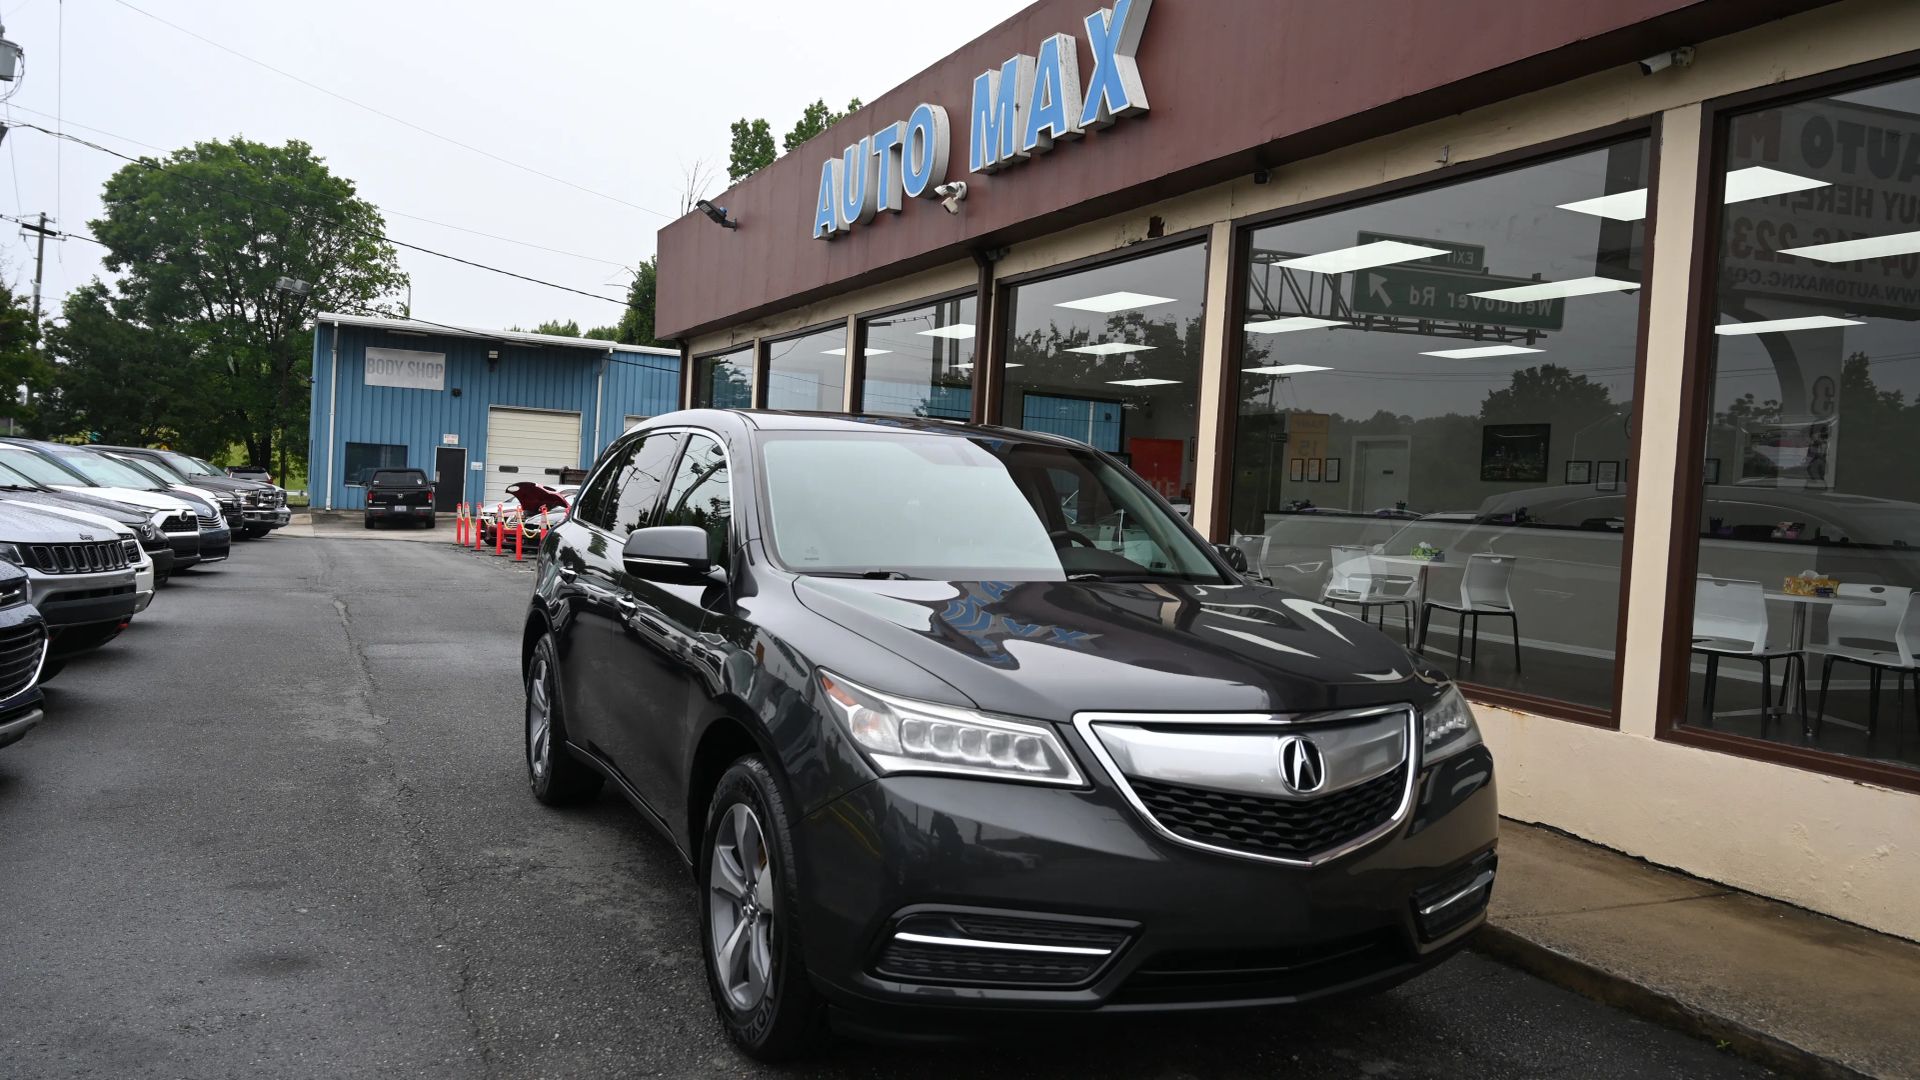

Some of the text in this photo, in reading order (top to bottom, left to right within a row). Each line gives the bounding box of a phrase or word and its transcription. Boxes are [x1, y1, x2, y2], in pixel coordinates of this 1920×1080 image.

[813, 0, 1153, 240] AUTO MAX
[367, 358, 443, 379] BODY SHOP
